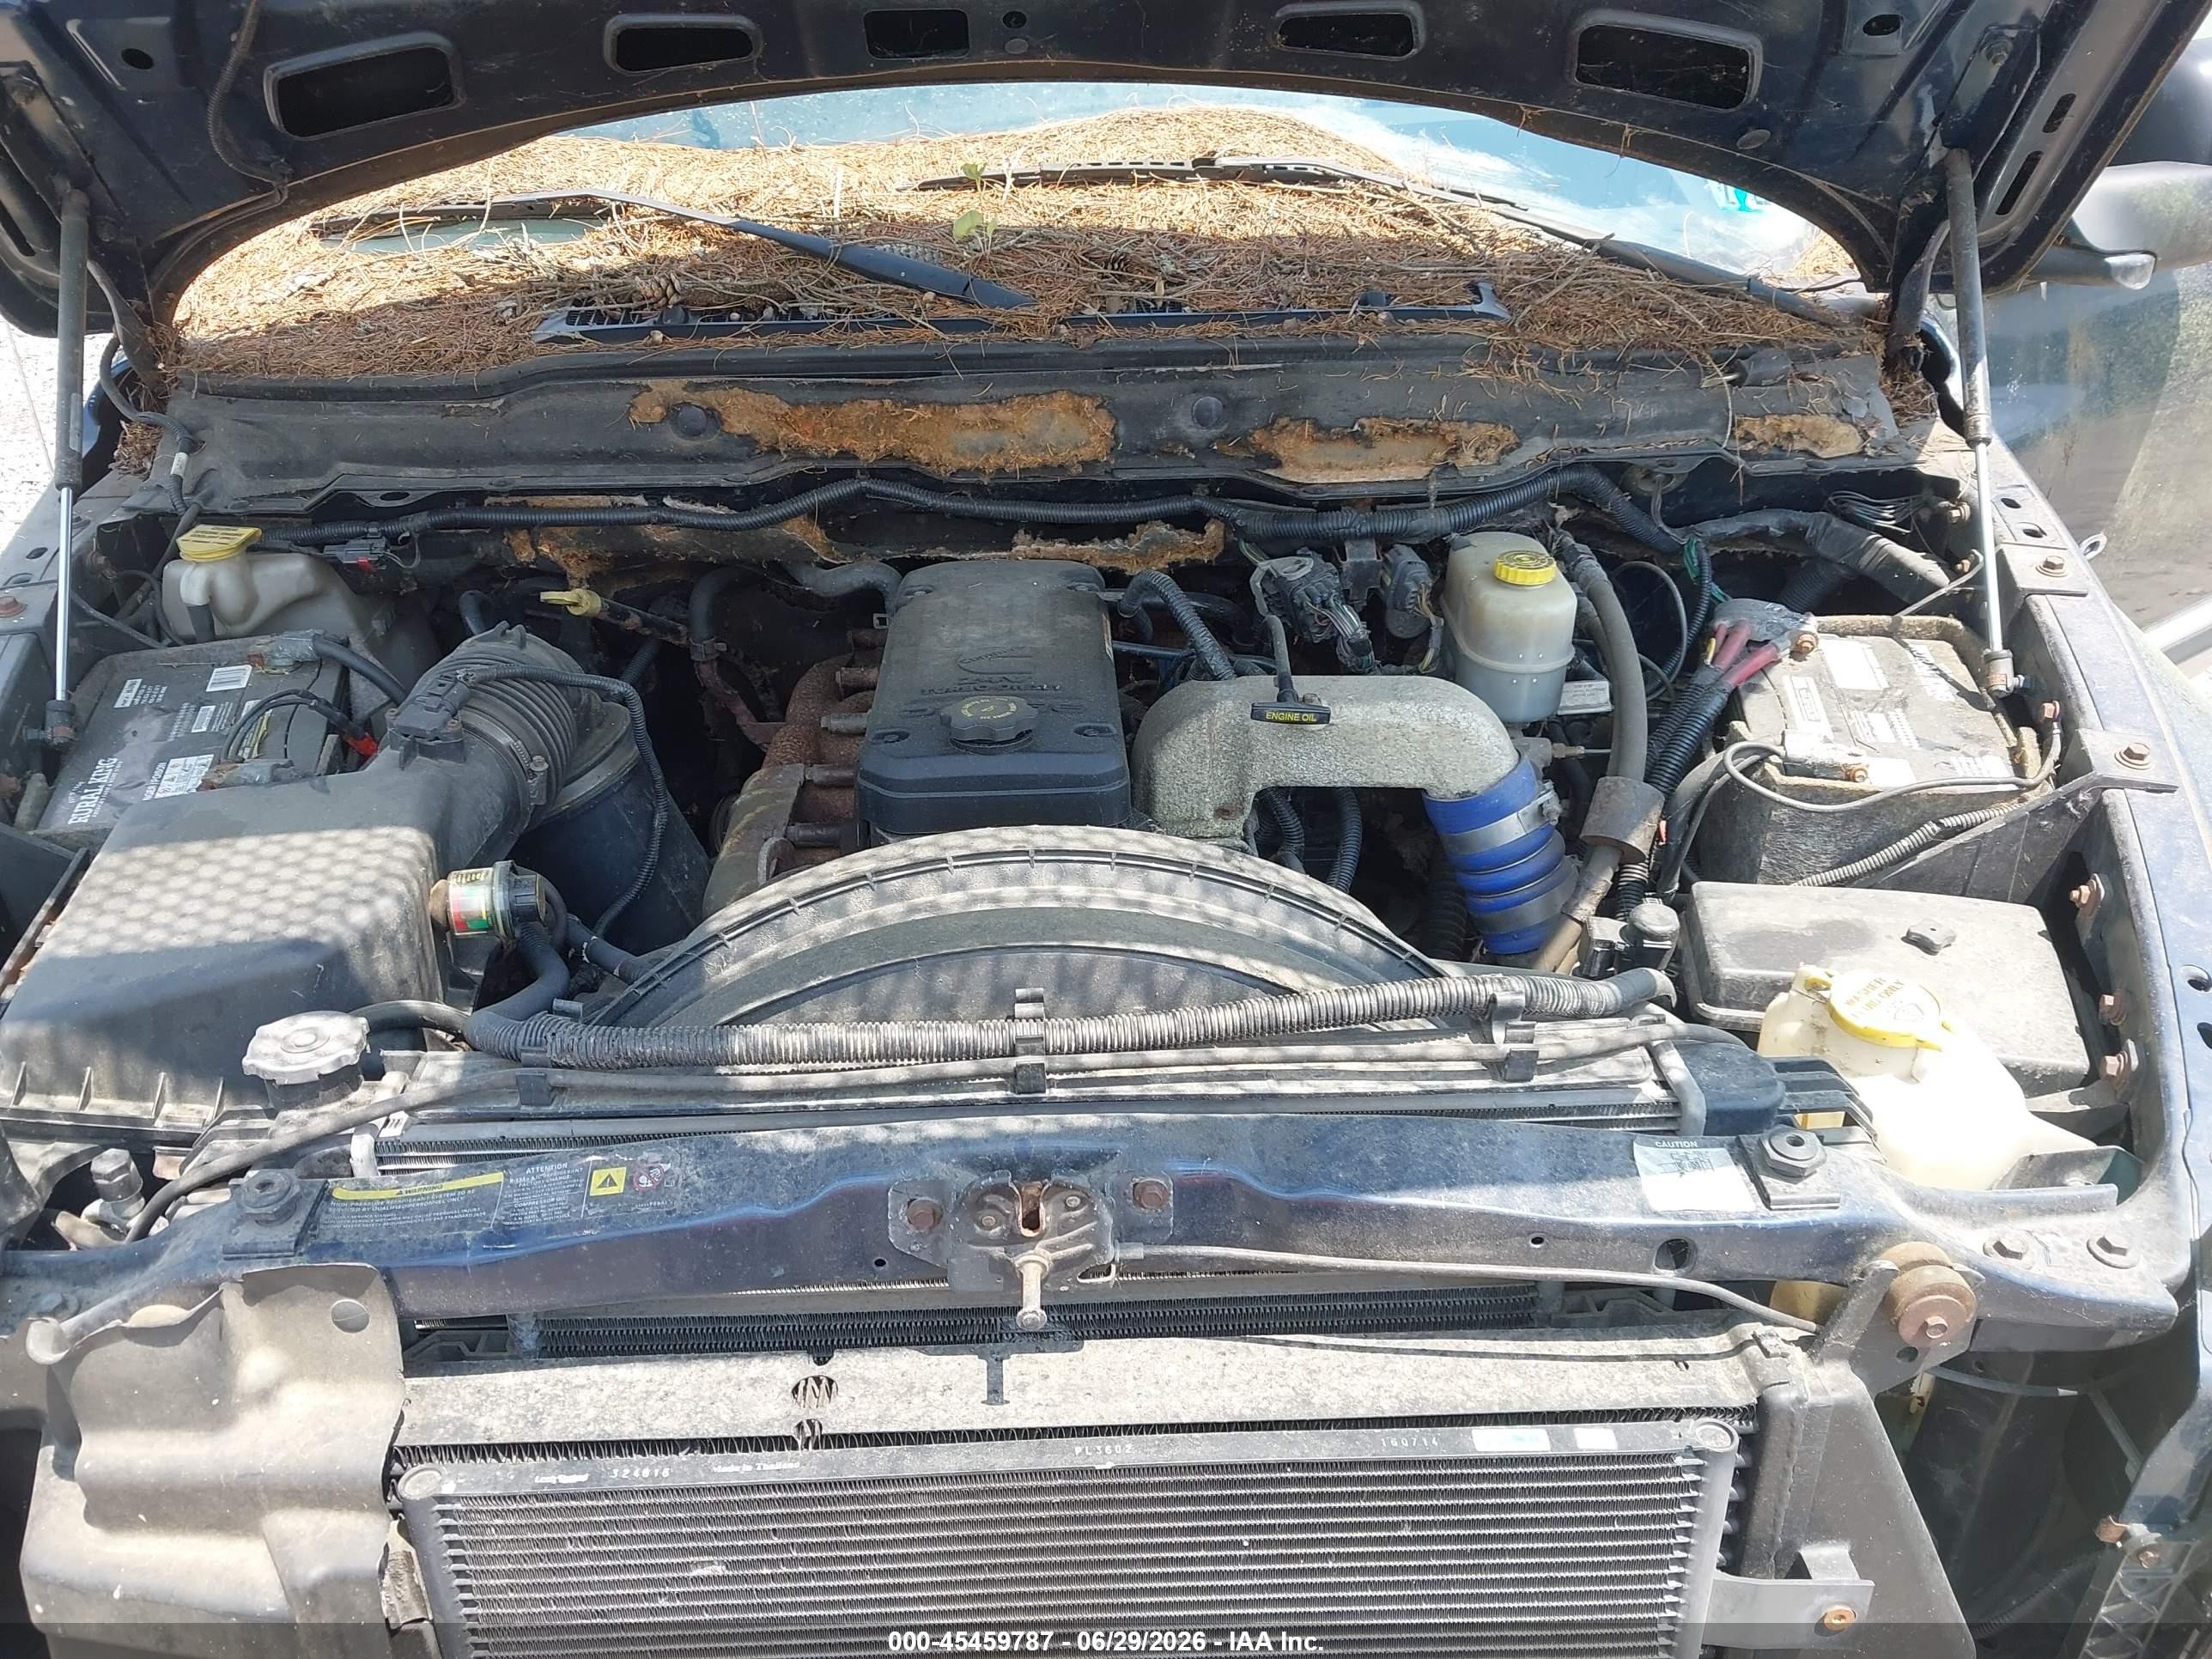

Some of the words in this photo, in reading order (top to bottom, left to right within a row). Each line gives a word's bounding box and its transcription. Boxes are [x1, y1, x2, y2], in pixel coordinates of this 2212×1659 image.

[1266, 712, 1300, 721] ENGINE
[1301, 714, 1317, 722] OIL
[150, 762, 168, 782] POISON
[68, 783, 105, 825] RURAL
[88, 757, 118, 785] KING
[526, 1162, 568, 1175] ATTENTION
[404, 1184, 443, 1194] WARNING
[1074, 1443, 1134, 1456] PL3602
[756, 1461, 800, 1471] Thailand
